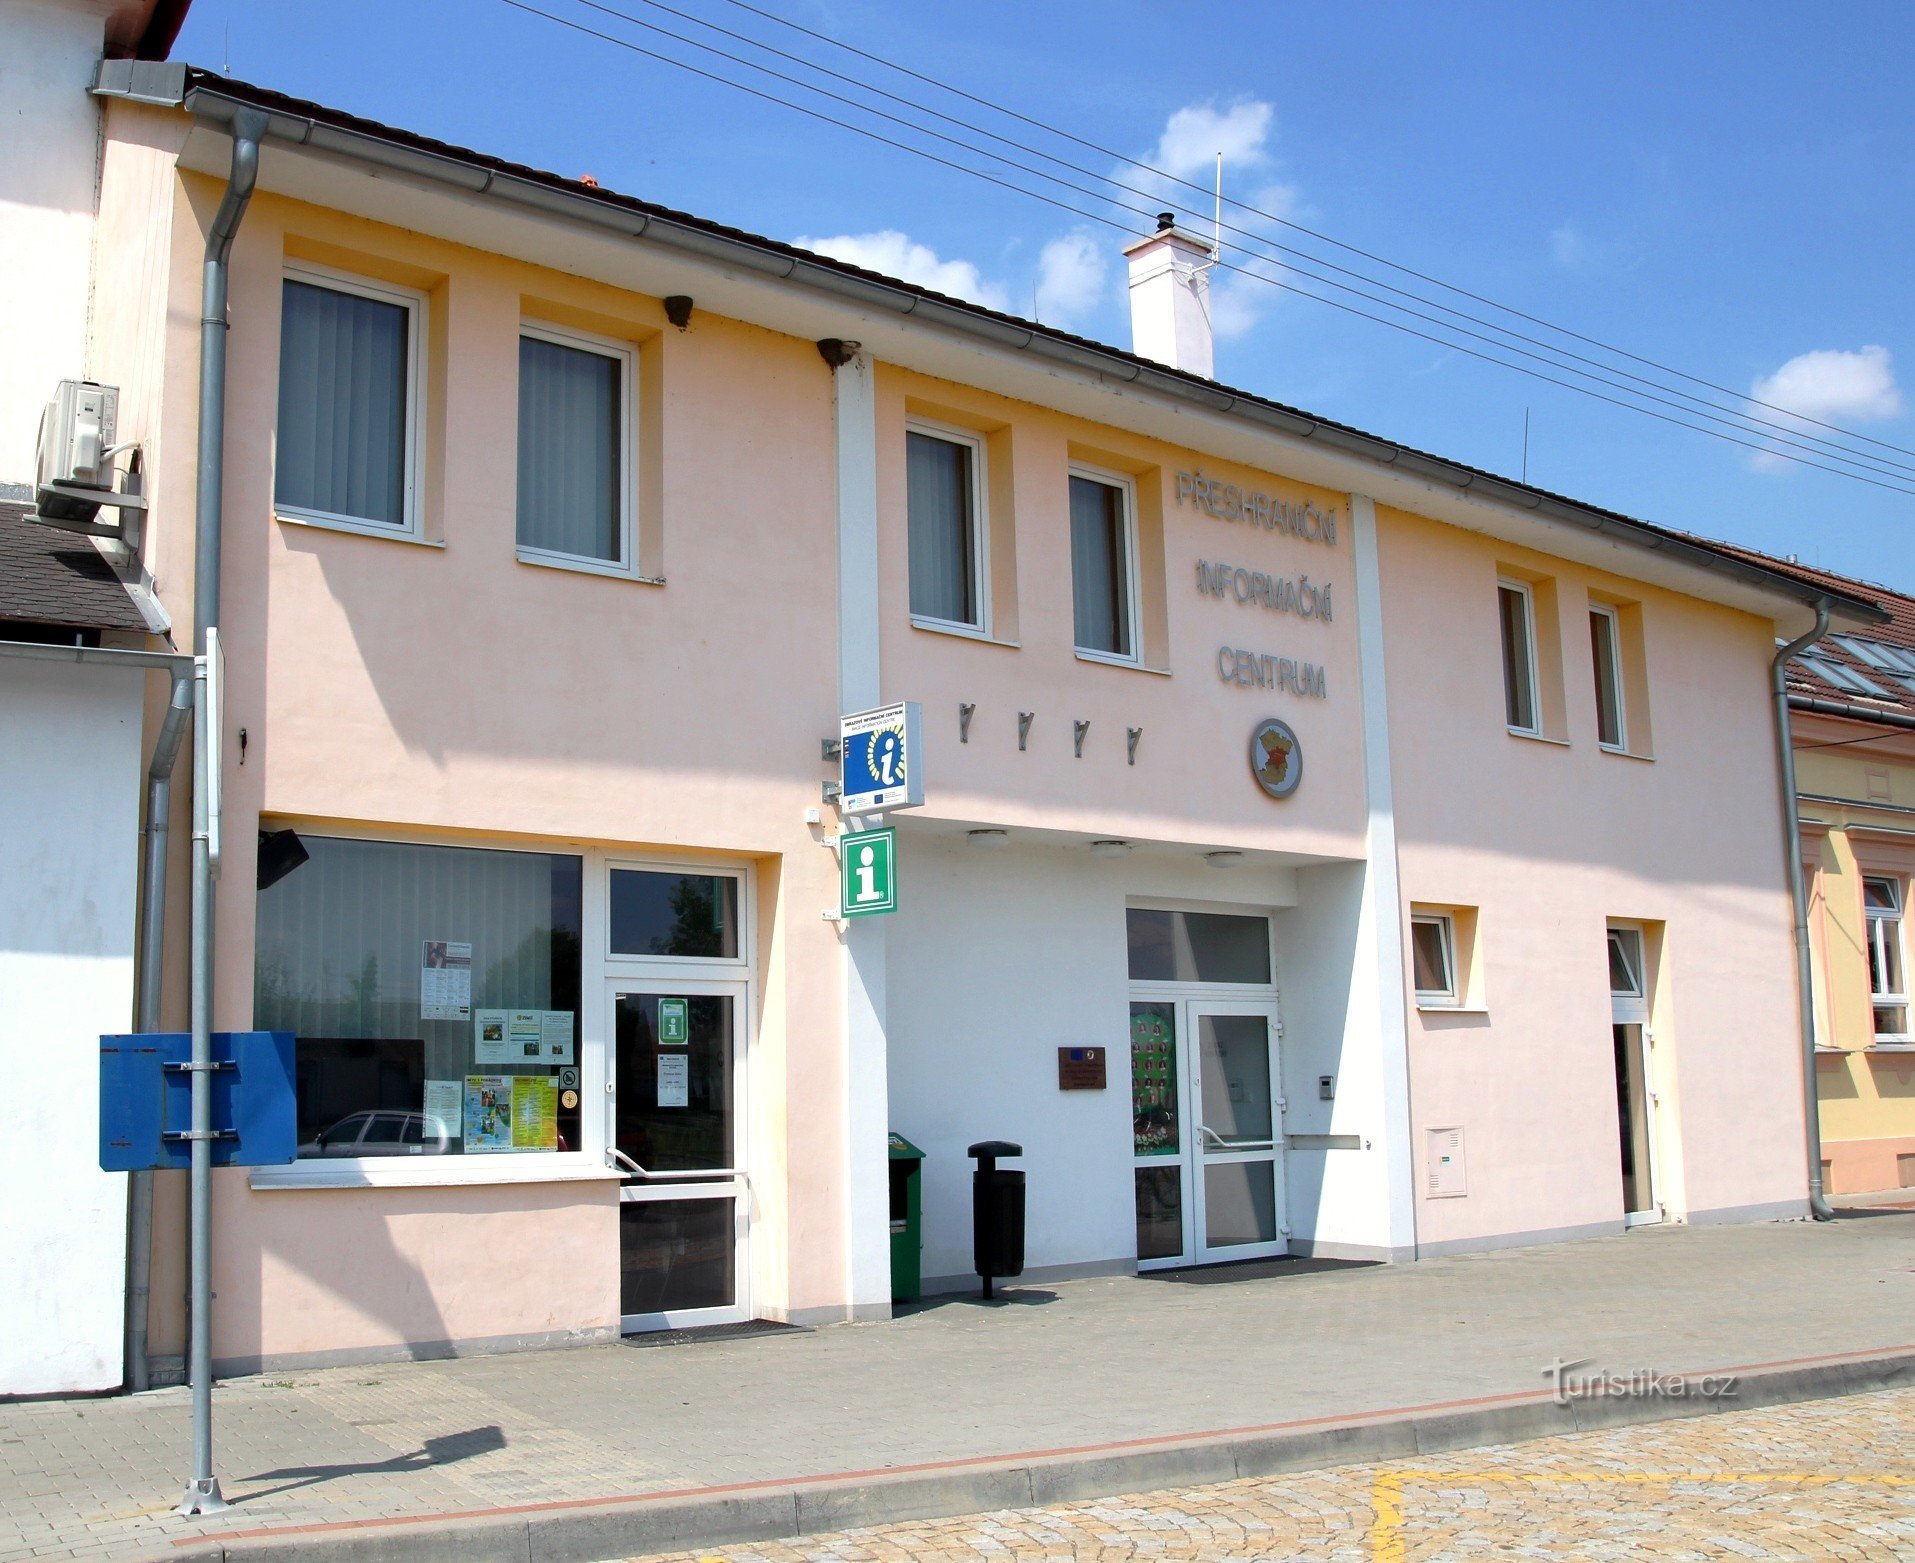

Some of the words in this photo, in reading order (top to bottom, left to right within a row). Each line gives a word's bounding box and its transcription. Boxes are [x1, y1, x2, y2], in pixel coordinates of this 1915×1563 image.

[1177, 469, 1337, 545] PŘESHRANIČNÍ
[1196, 557, 1333, 622] INFORMAČNÍ
[1218, 645, 1327, 699] CENTRUM
[886, 710, 903, 718] CENTRUM
